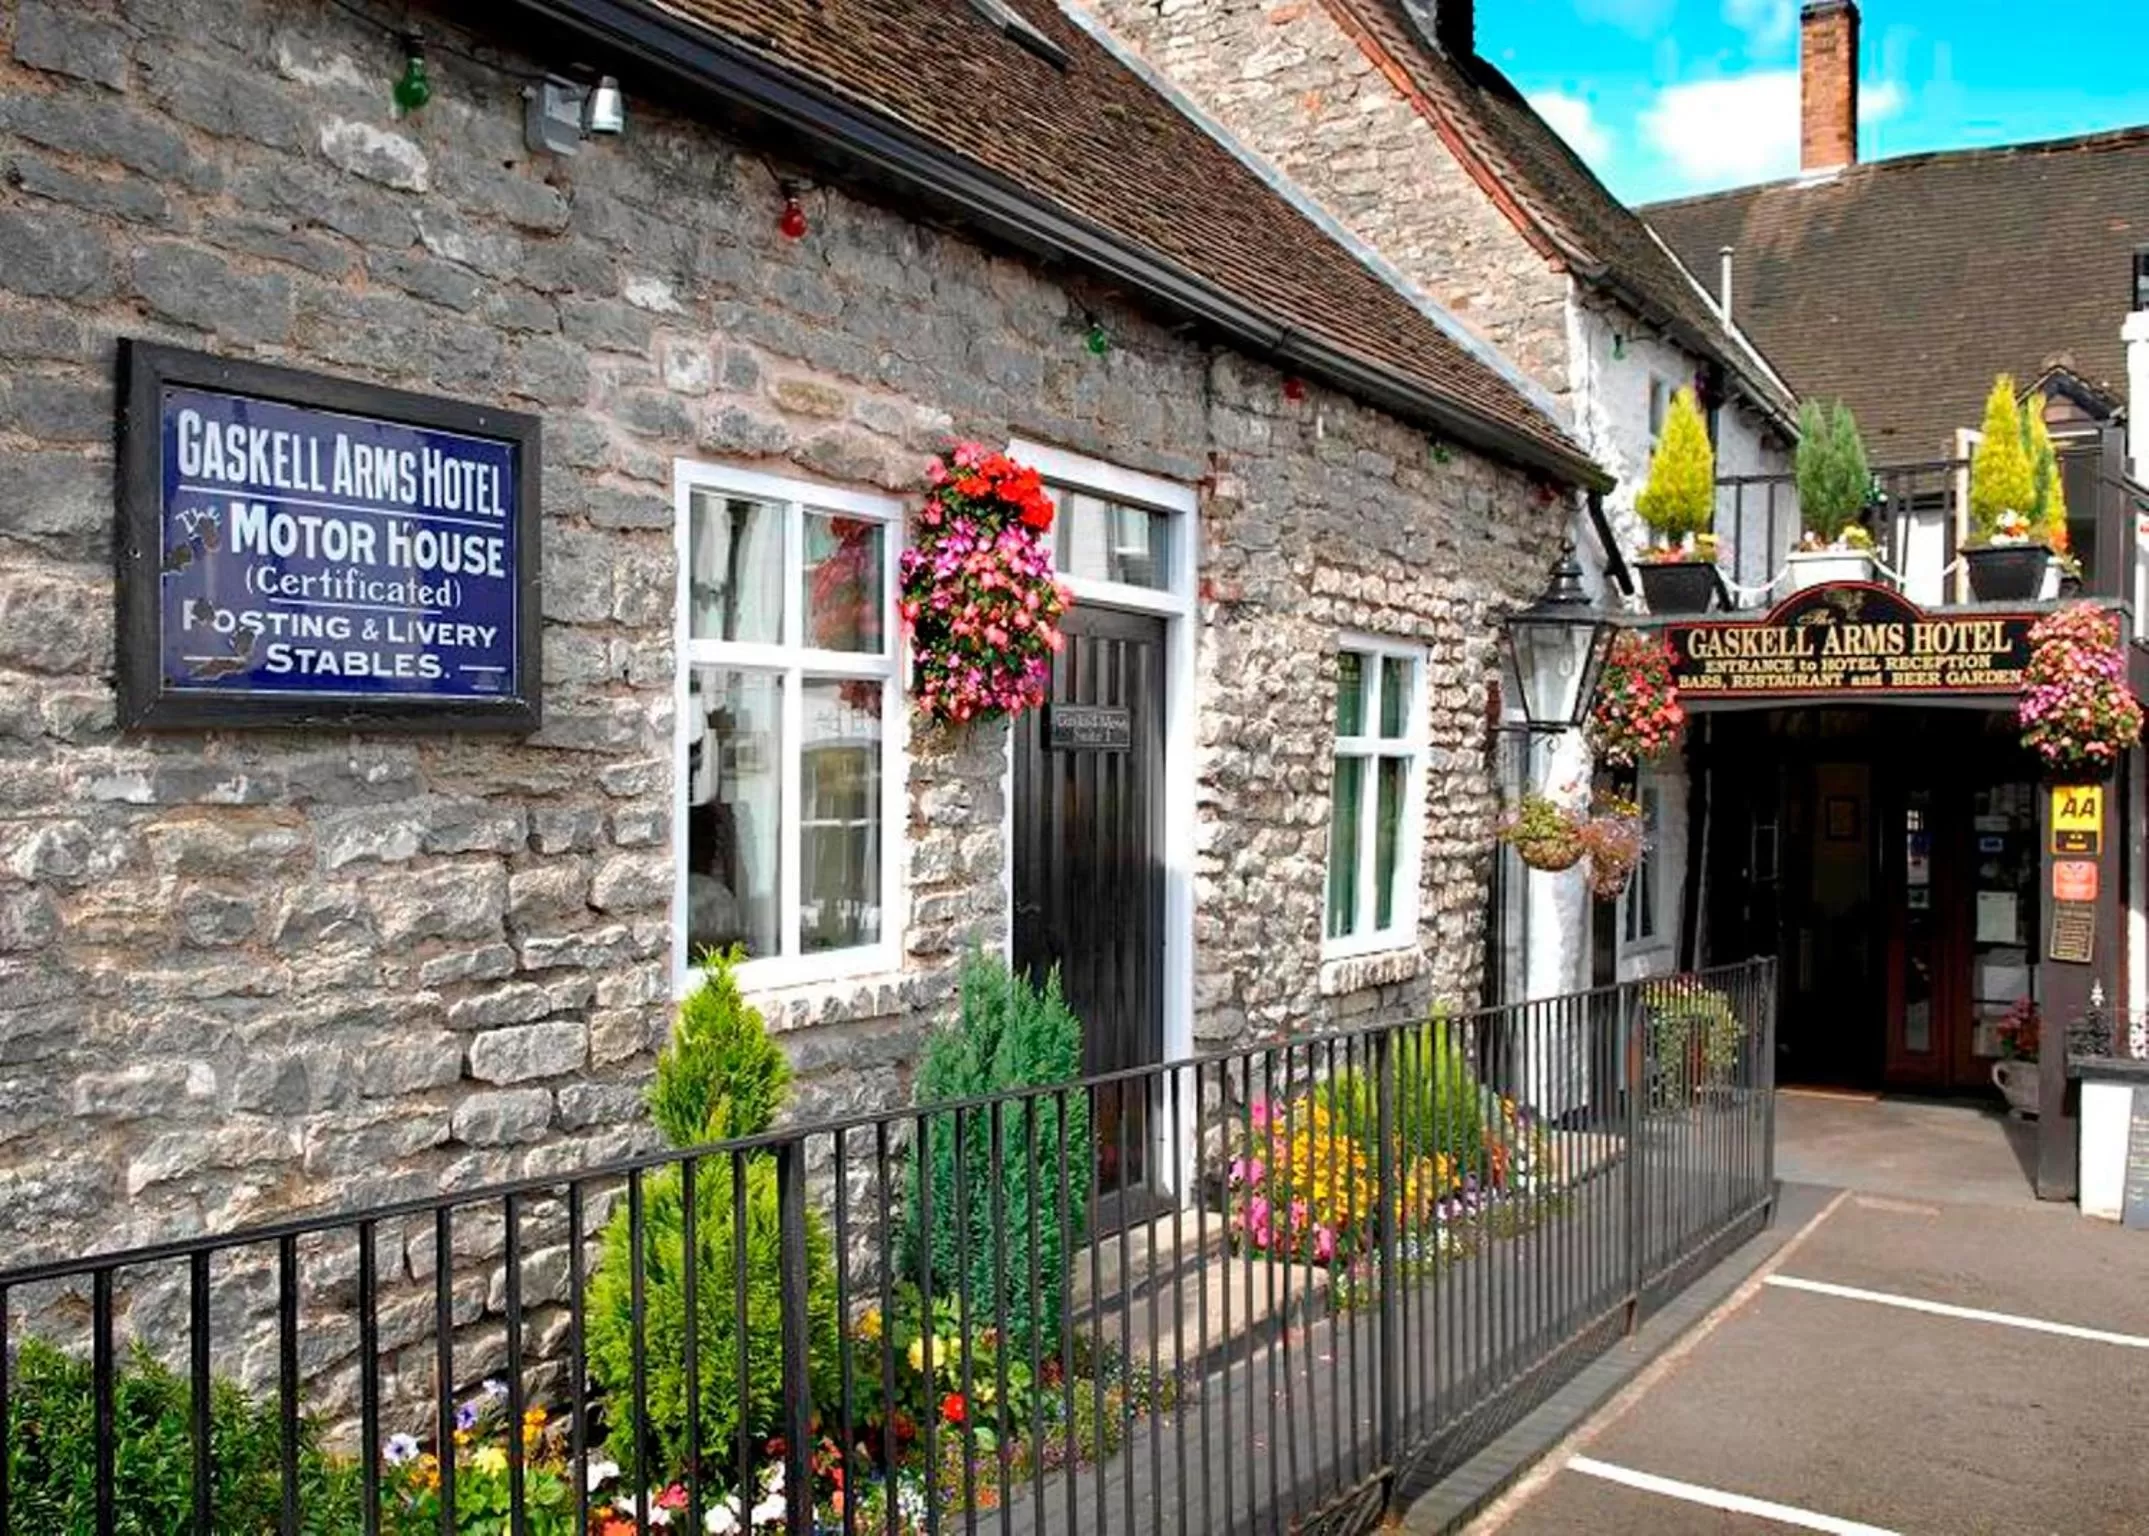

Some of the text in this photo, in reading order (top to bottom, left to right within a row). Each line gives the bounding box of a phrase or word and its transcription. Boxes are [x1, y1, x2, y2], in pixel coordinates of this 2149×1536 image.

[177, 408, 506, 517] GASKELL ARMS HOTEL
[230, 501, 506, 578] MOTOR HOUSE
[245, 564, 461, 608] (Certificated)
[361, 618, 379, 641] &
[387, 616, 497, 648] LIVERY
[1687, 620, 2013, 659] GASKELL ARMS HOTEL
[265, 643, 451, 679] STABLES.
[1705, 655, 1992, 674] ENTRANCE to HOTEL RECEPTION
[1679, 670, 2022, 690] BARS, RESTAURANT and BEER GARDEN
[2060, 797, 2096, 820] AA
